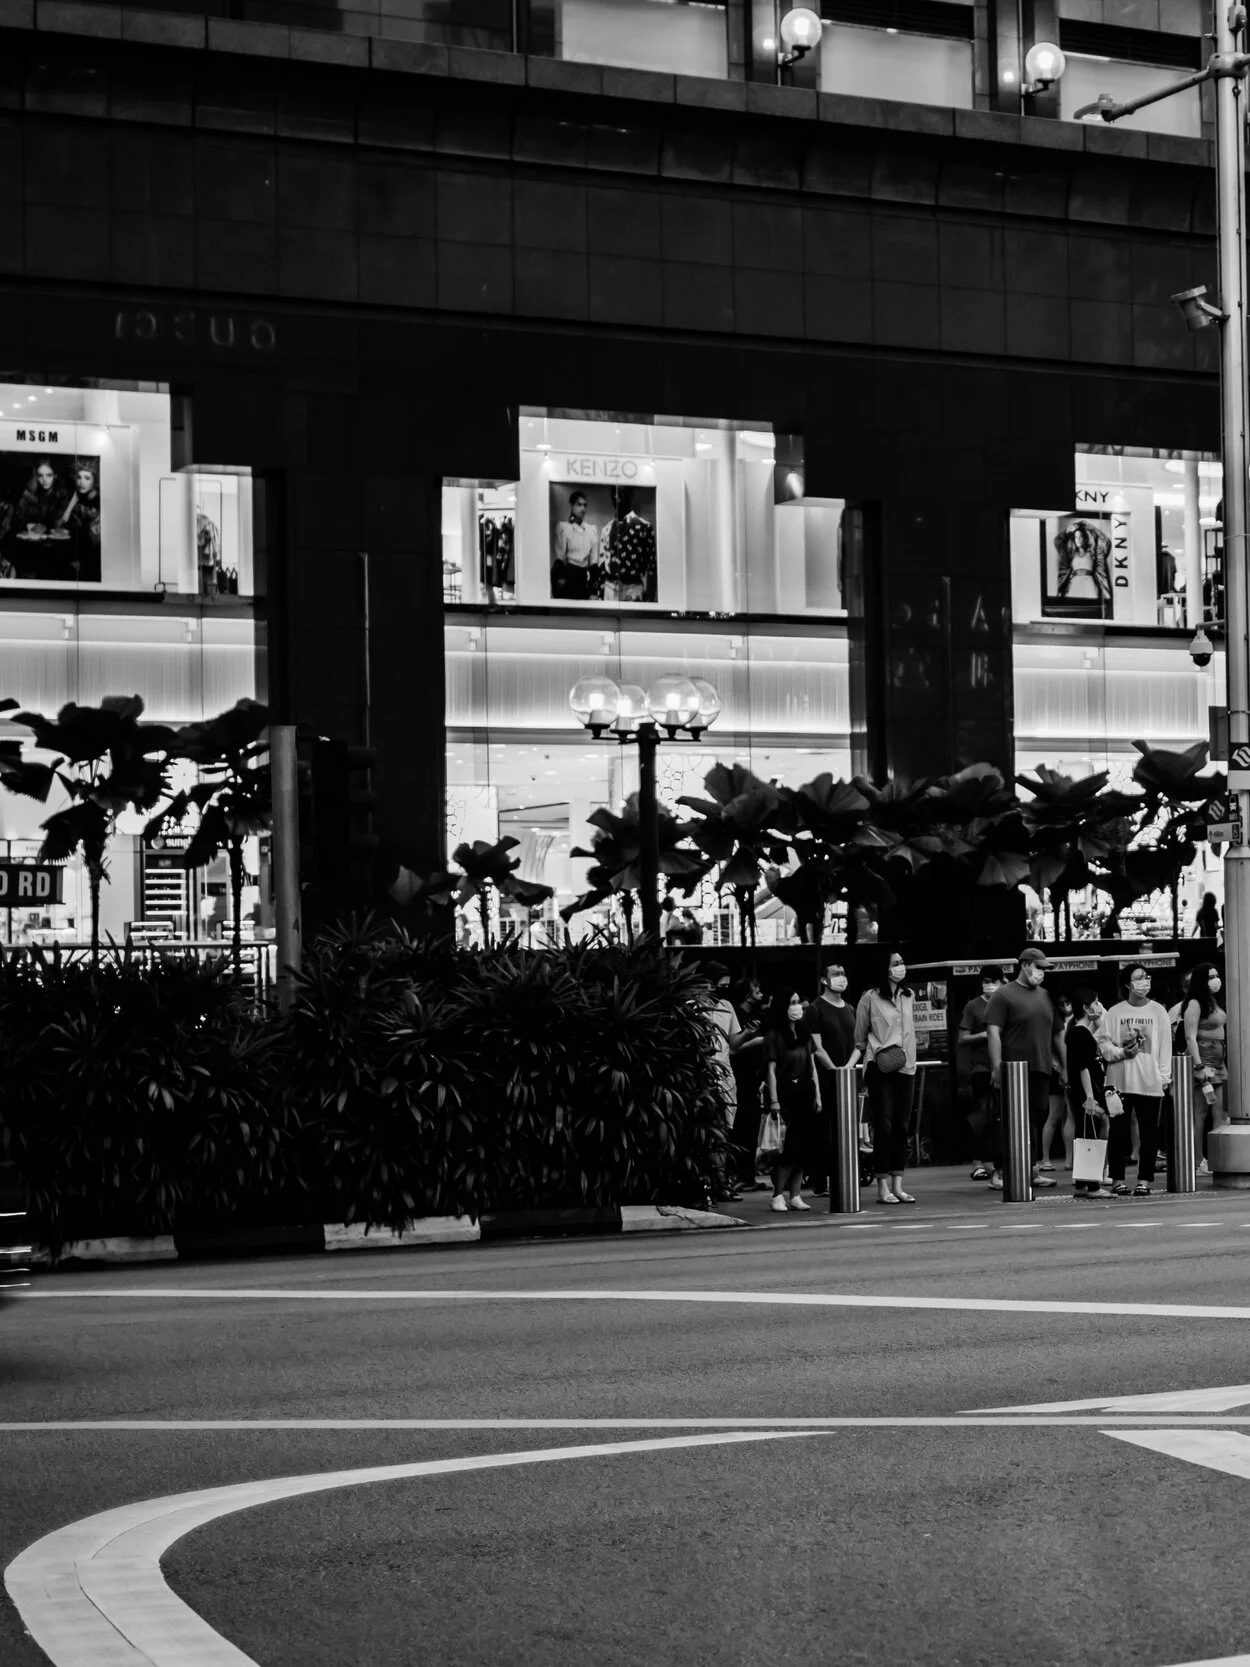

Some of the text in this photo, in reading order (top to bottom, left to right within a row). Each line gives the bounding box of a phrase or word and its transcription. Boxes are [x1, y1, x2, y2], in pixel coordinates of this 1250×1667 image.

[16, 429, 58, 443] MSGM
[566, 459, 638, 479] KENZO
[1114, 518, 1128, 588] DKNY
[18, 871, 51, 897] RD
